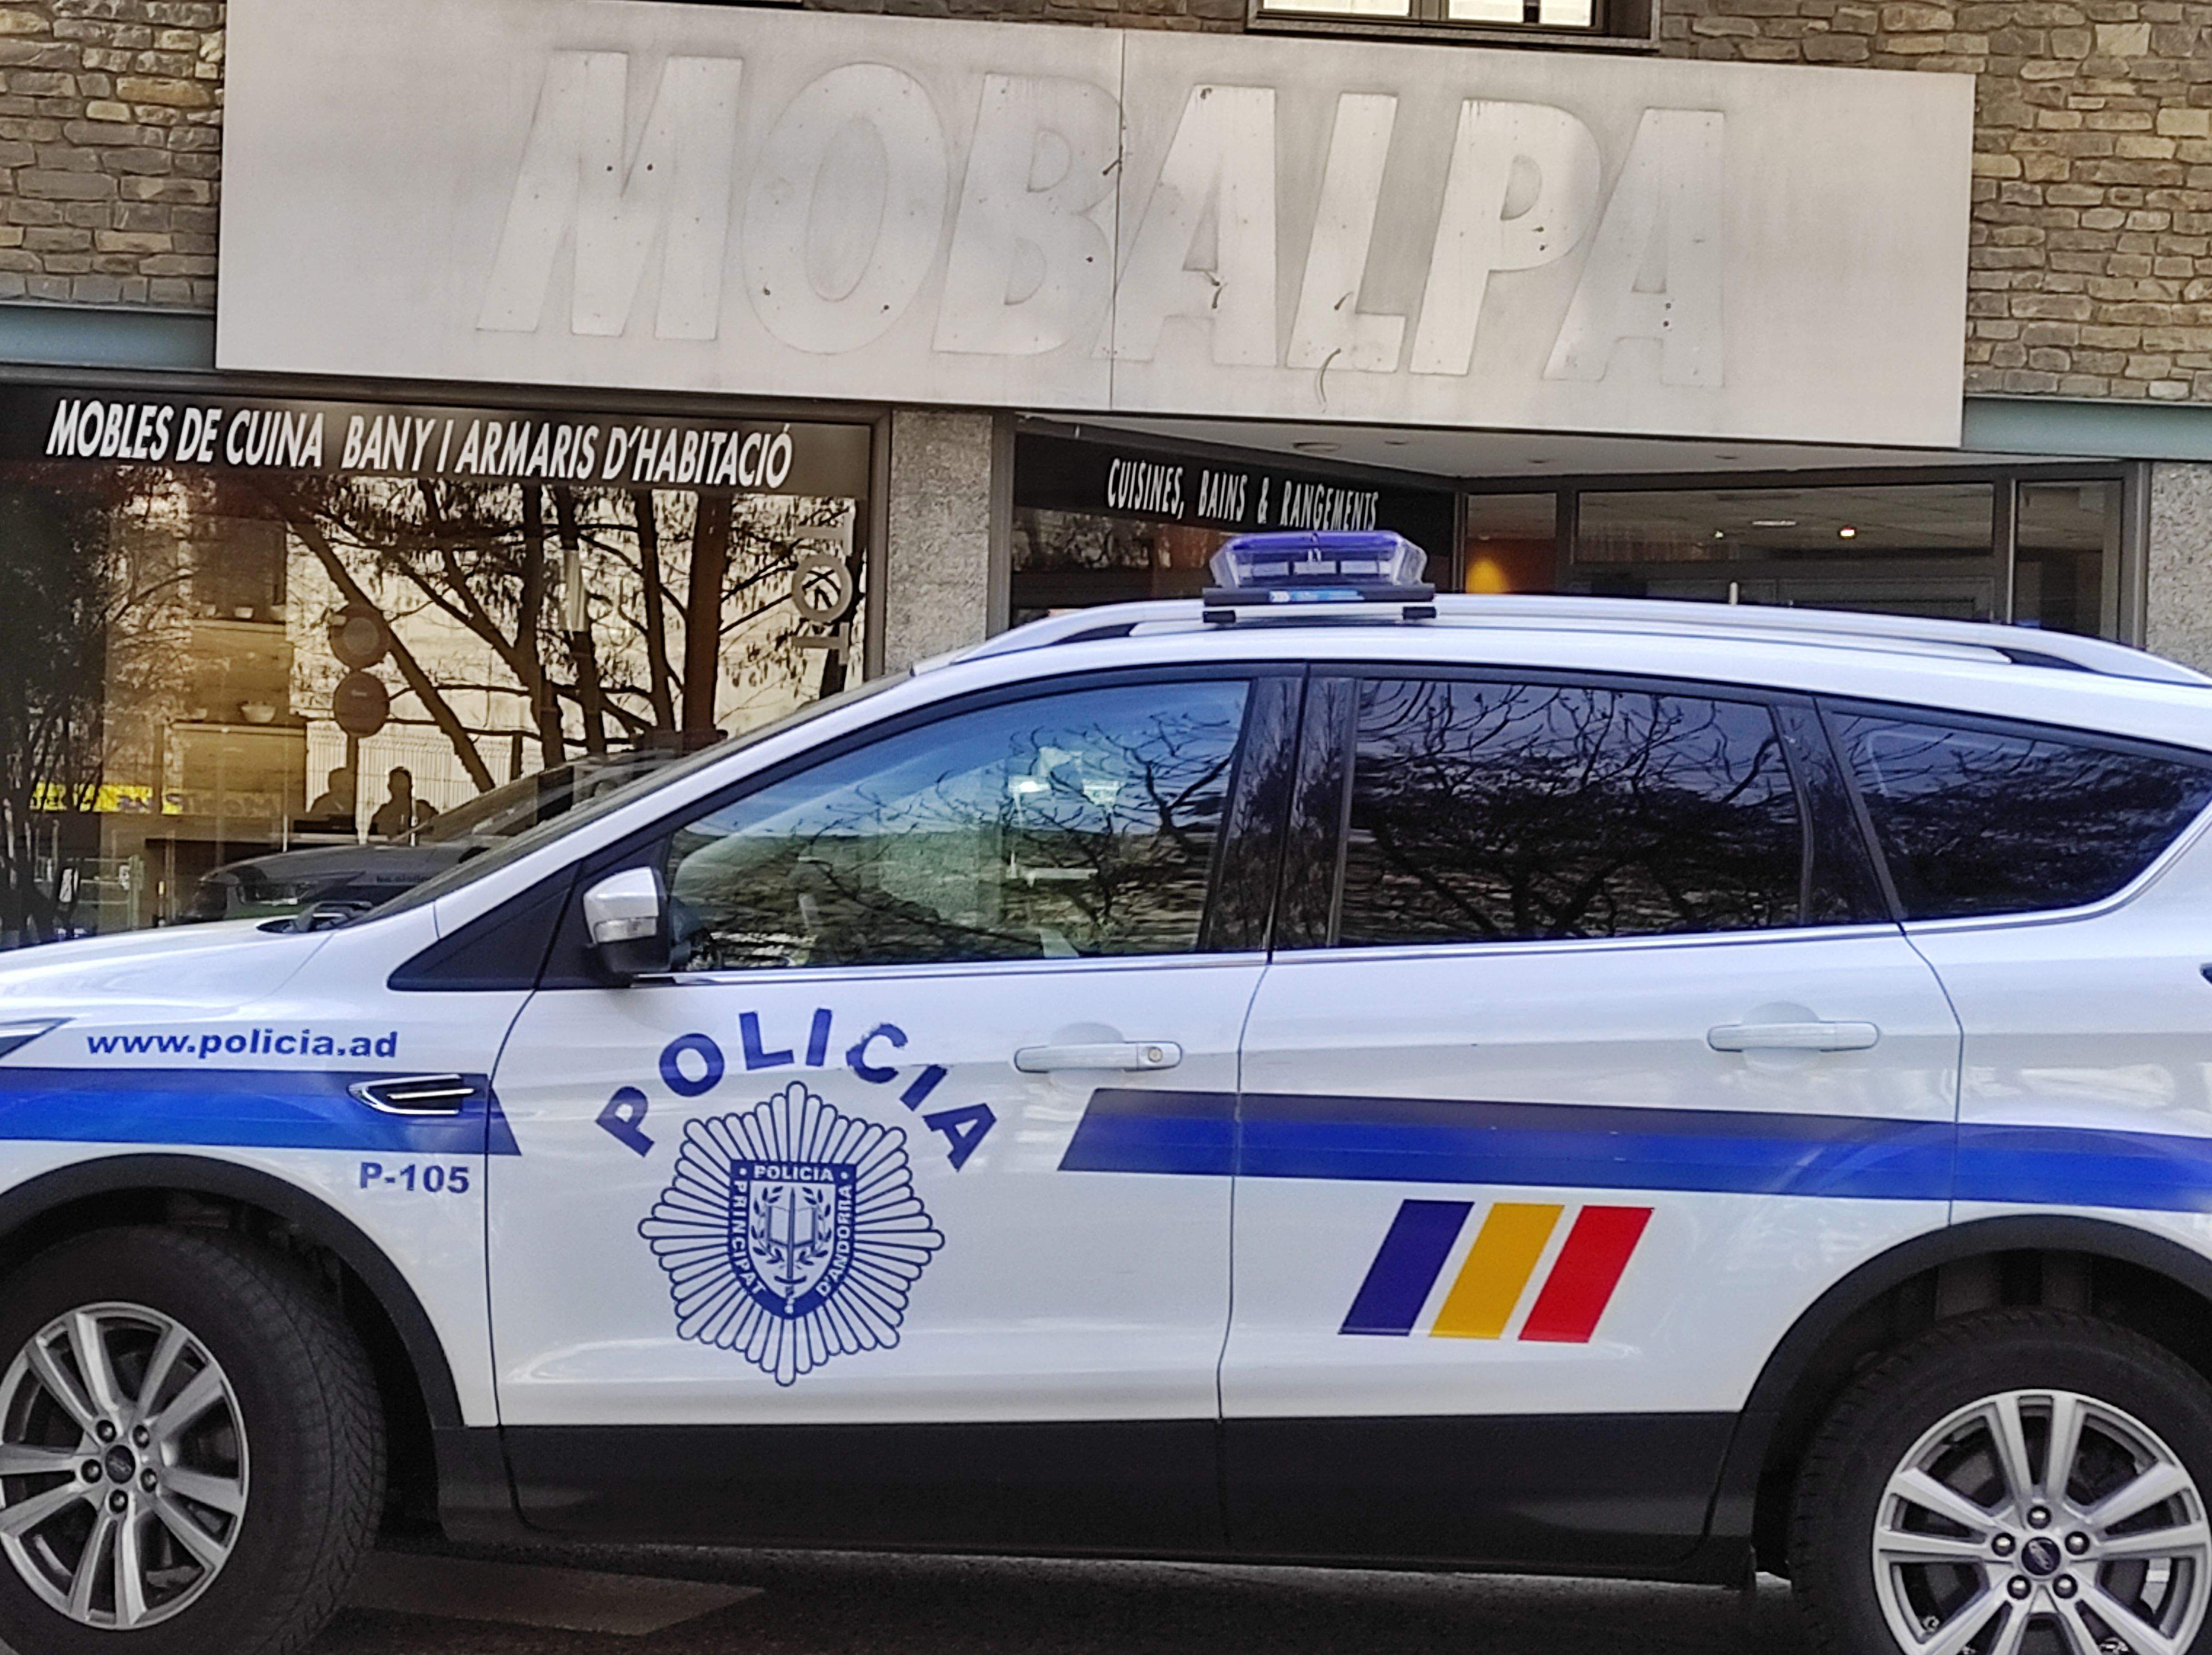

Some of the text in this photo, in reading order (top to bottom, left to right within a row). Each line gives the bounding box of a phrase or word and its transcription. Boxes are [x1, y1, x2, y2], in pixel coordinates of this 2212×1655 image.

[477, 49, 1726, 387] MOBALPA
[46, 398, 793, 489] MOBLES DE CUINA BANY I ARMARIS D'HABITACIÓ
[1107, 458, 1380, 531] CUISINES, BAINS & RANGEMENTS
[87, 1028, 398, 1059] www.policia.ad
[594, 1008, 997, 1172] POLICIA
[360, 1162, 470, 1194] P-105
[753, 1165, 834, 1182] POLICIA
[731, 1180, 766, 1294] PRINCIPAT
[816, 1185, 852, 1297] D'ANDORRA
